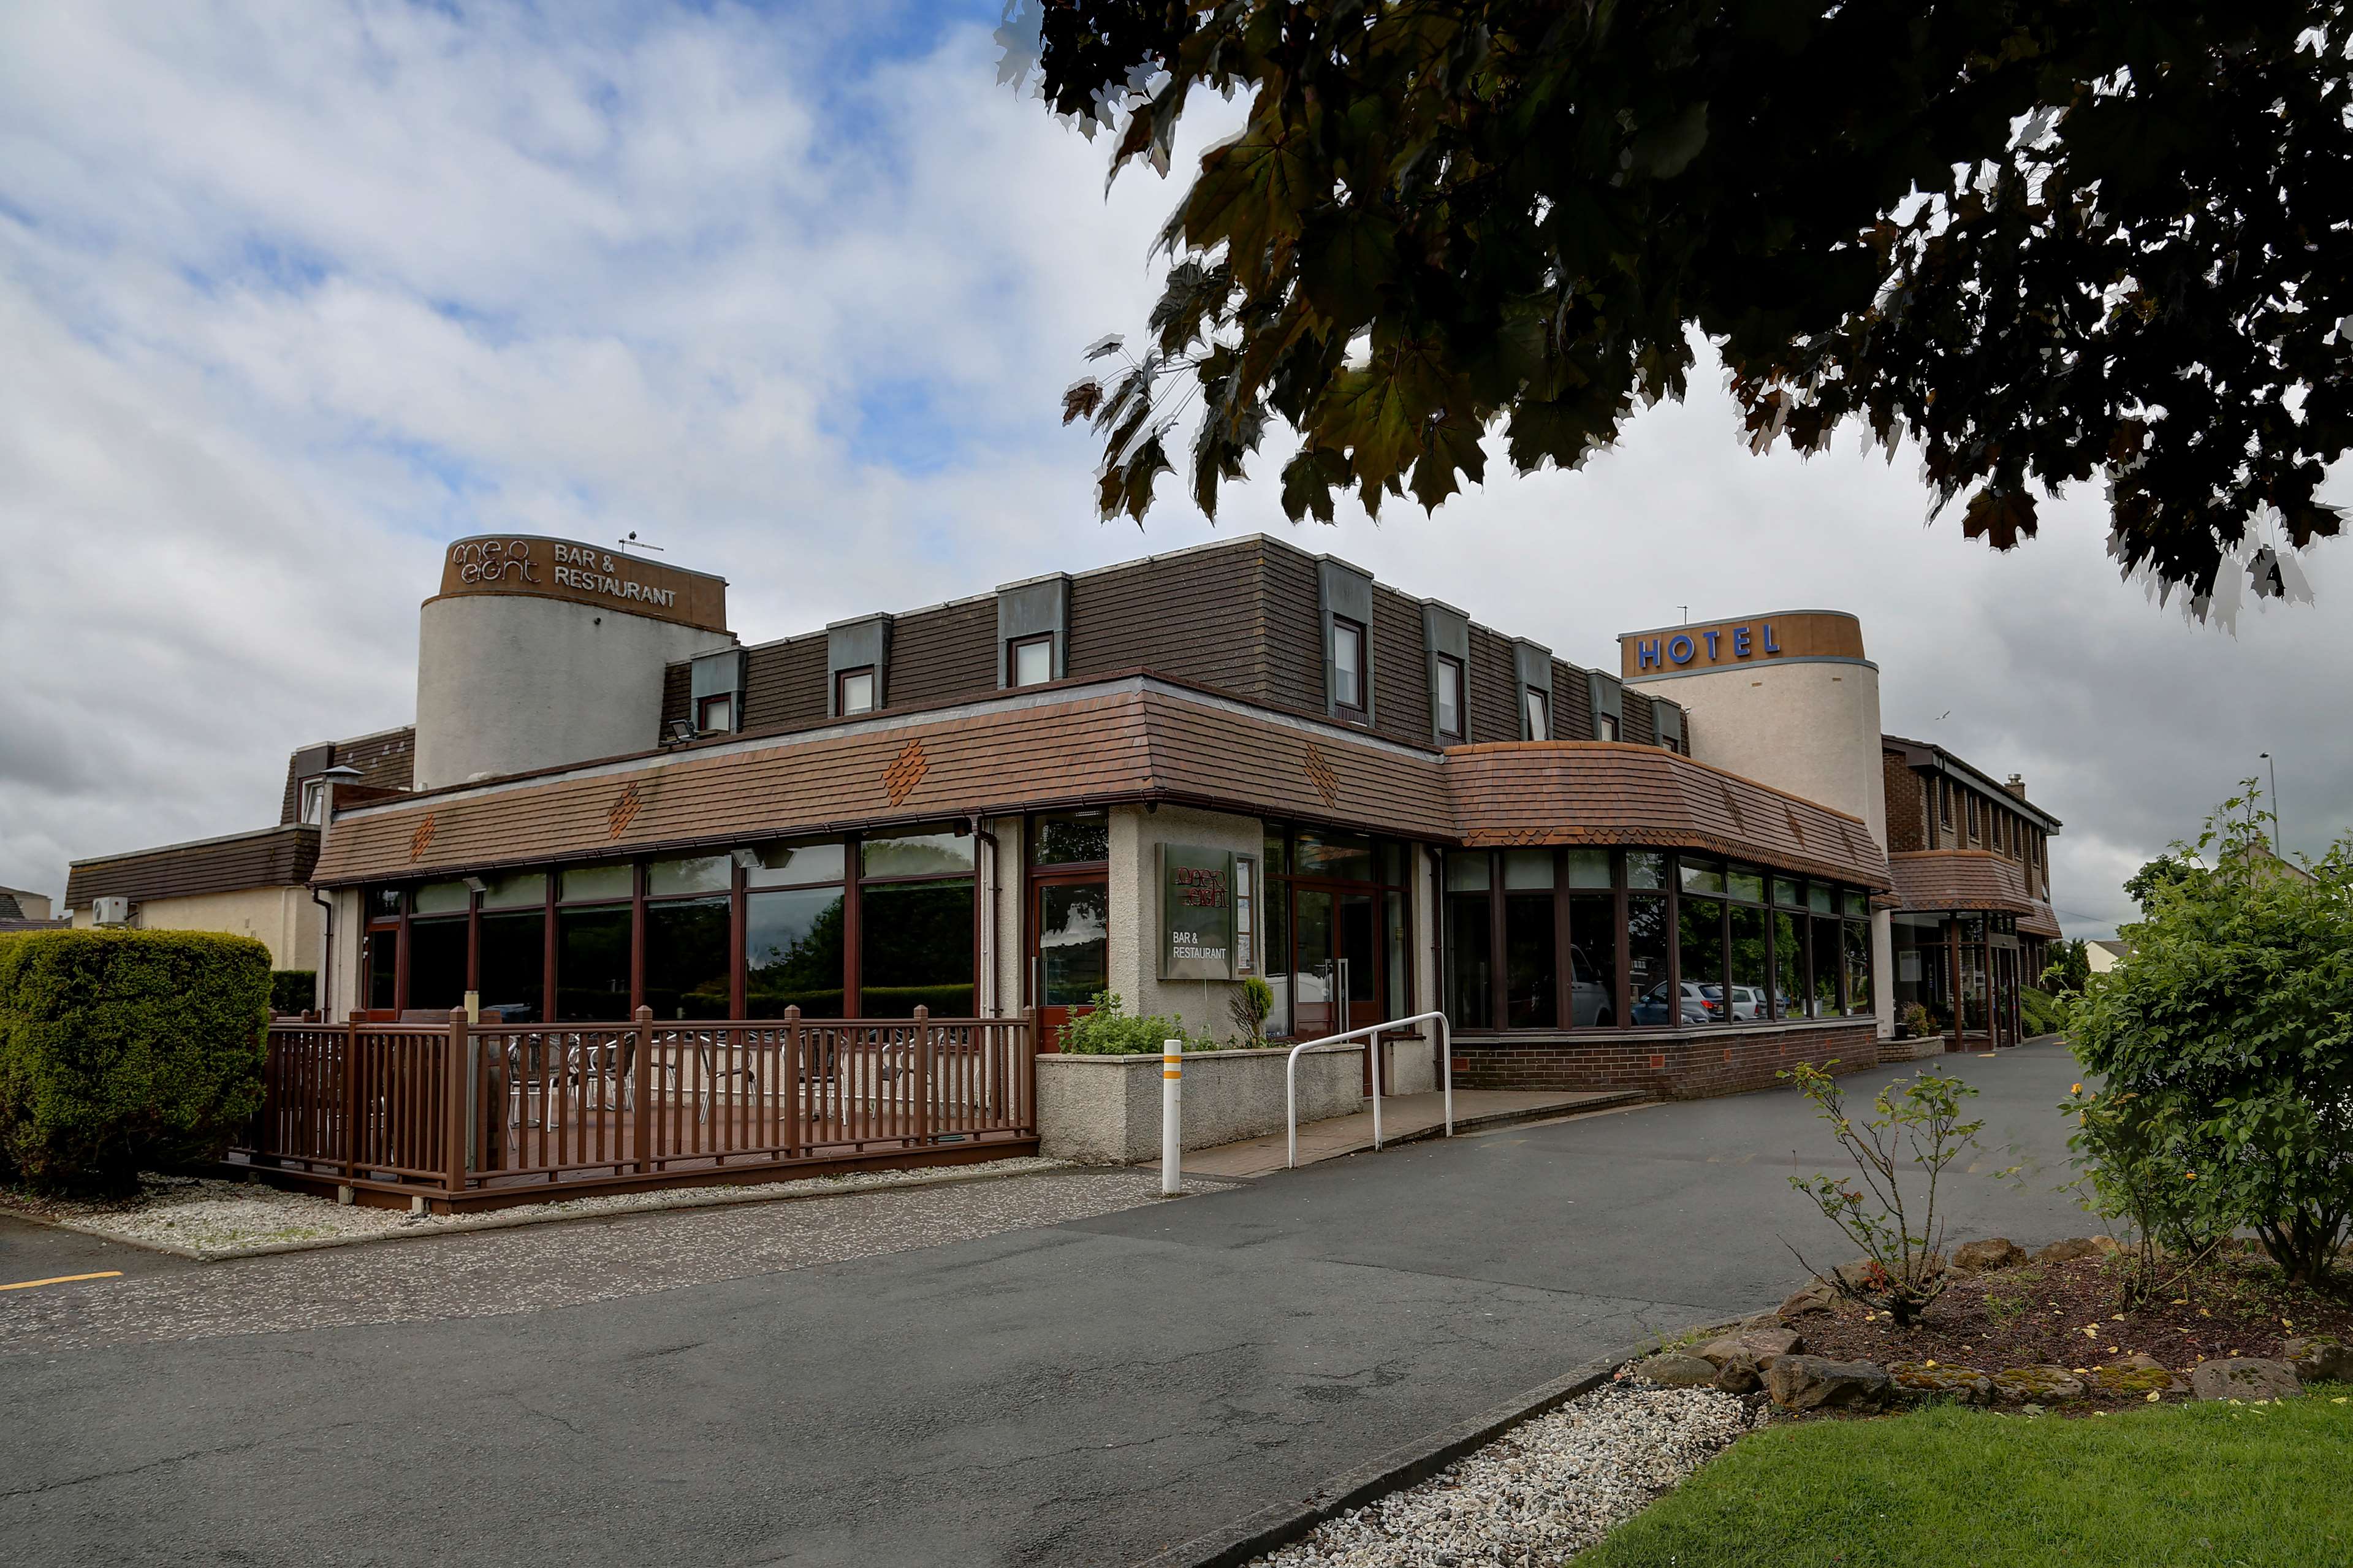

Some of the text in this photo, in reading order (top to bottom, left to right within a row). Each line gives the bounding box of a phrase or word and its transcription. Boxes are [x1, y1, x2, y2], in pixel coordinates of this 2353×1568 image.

[461, 551, 542, 584] eight
[554, 544, 615, 573] BAR &
[554, 566, 677, 608] RESTAURANT
[1638, 623, 1781, 669] HOTEL
[1173, 931, 1198, 944] BAR &
[1173, 946, 1226, 960] RESTAURANT
